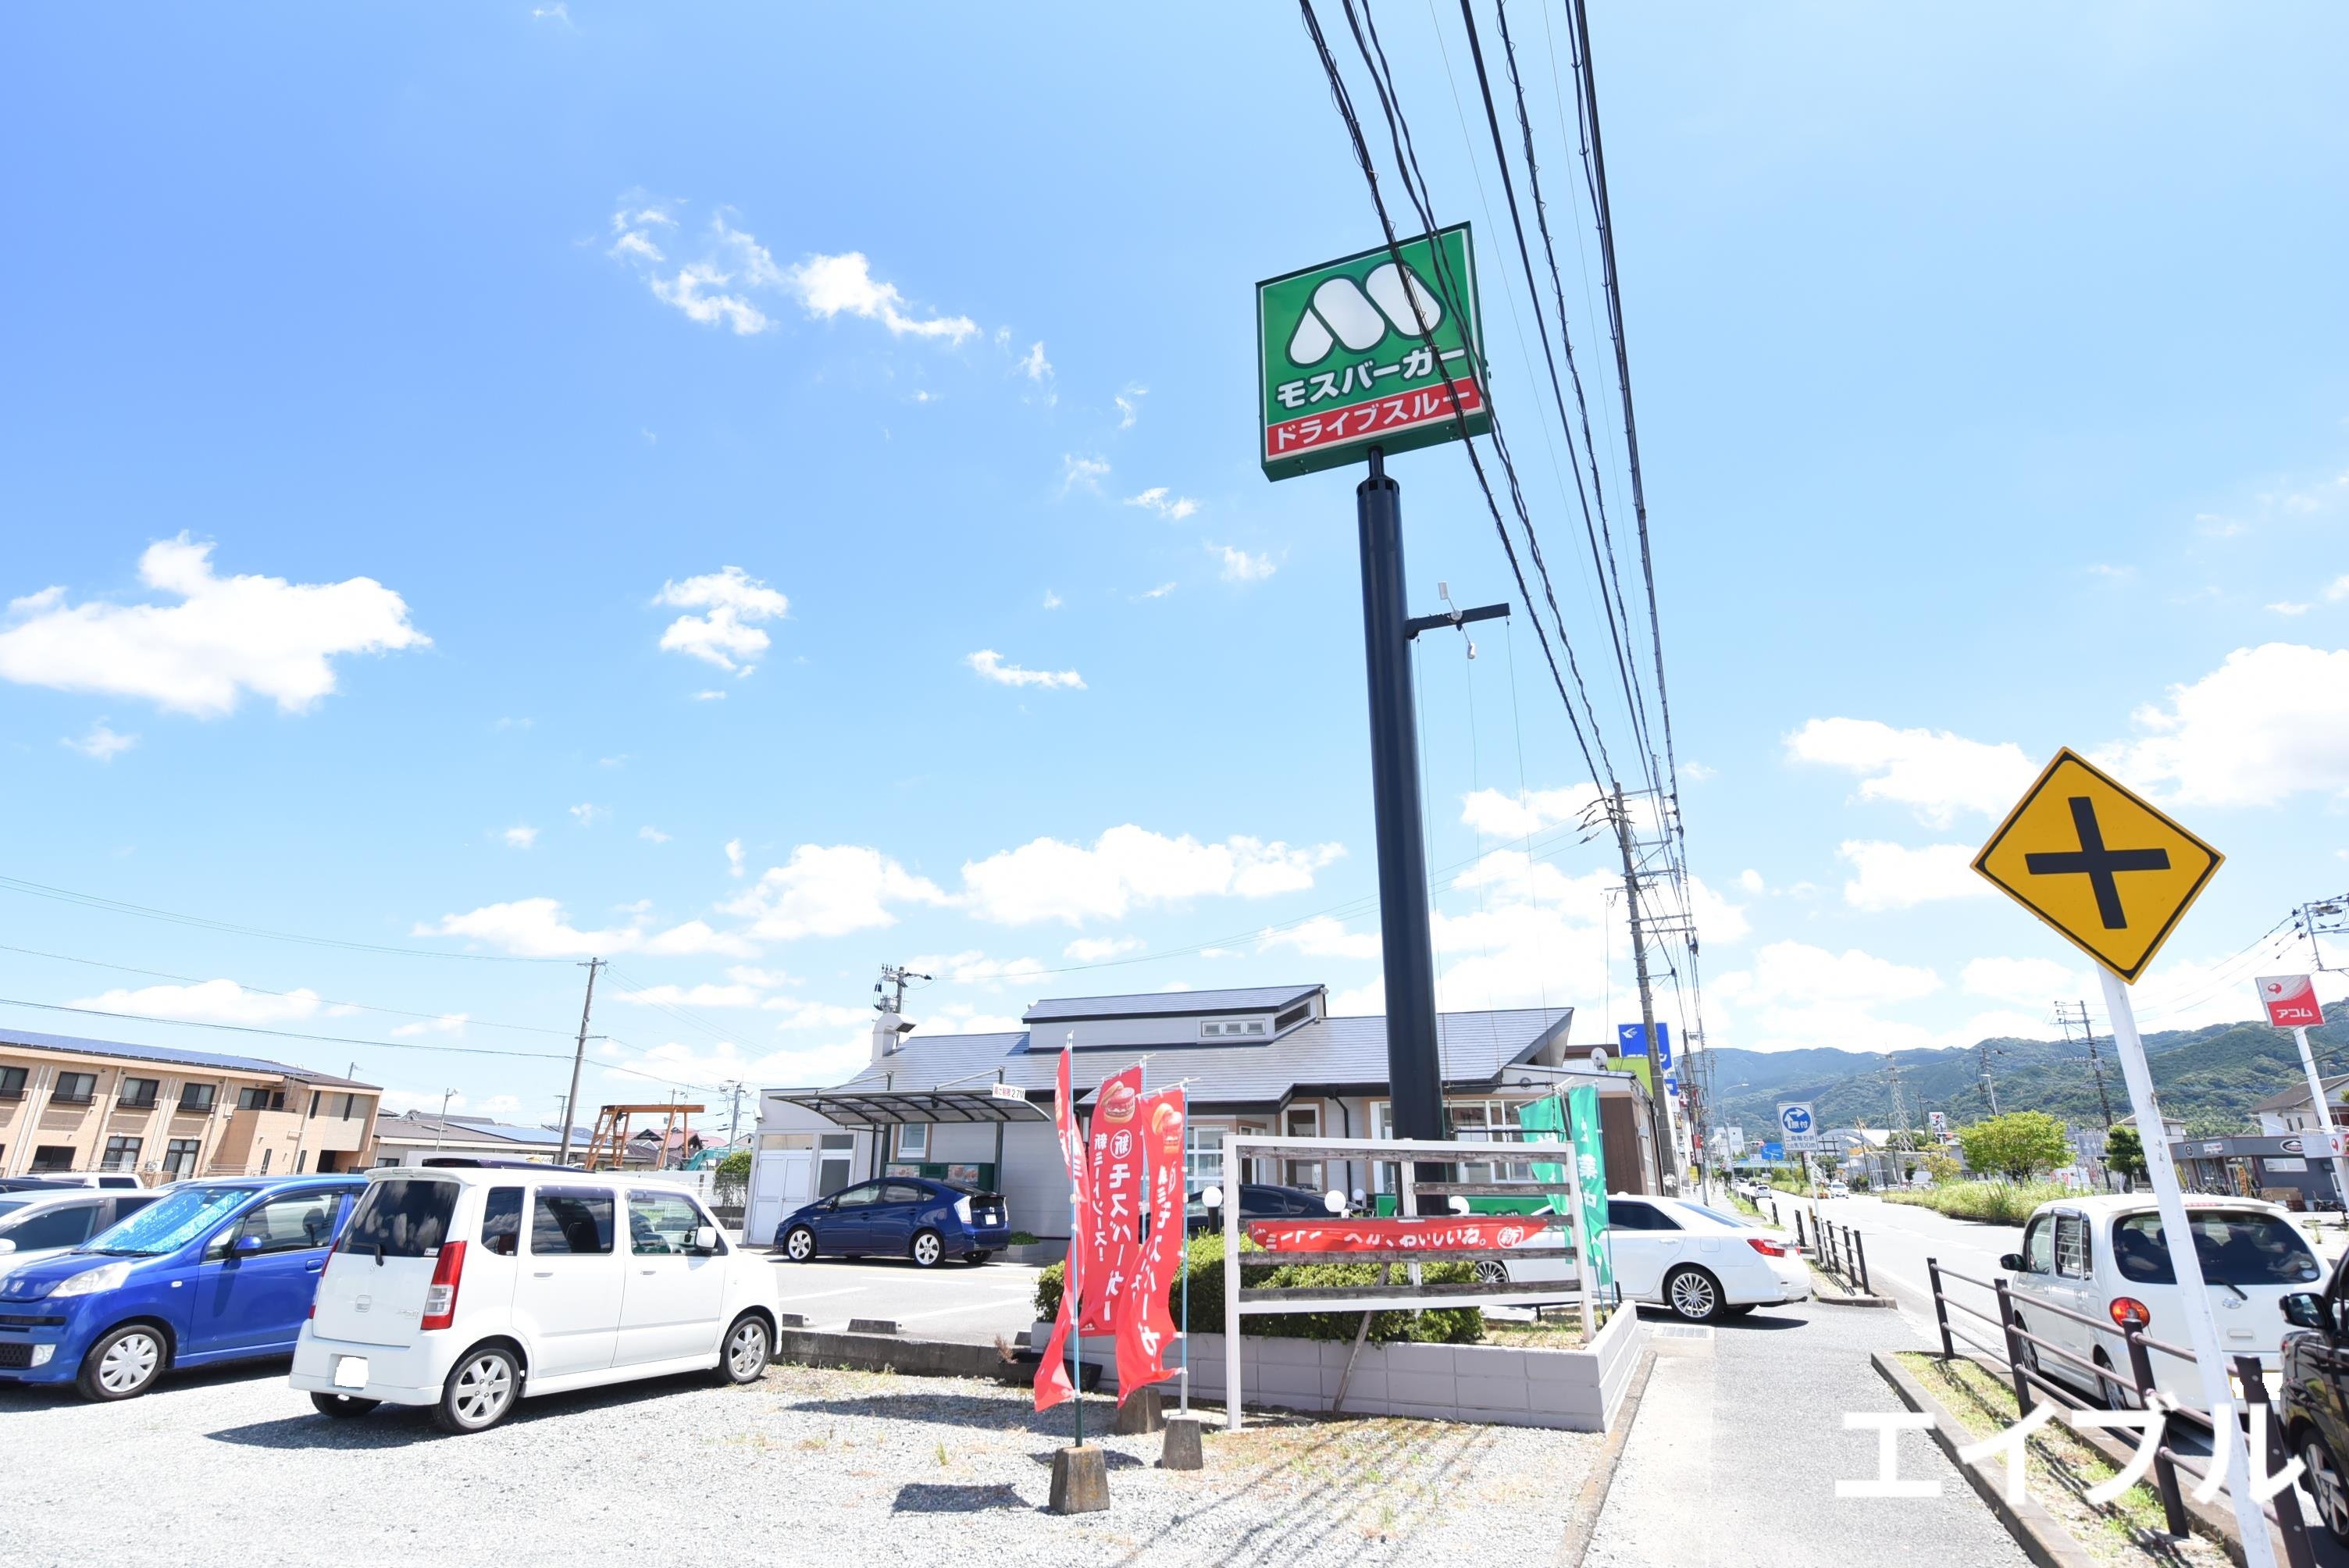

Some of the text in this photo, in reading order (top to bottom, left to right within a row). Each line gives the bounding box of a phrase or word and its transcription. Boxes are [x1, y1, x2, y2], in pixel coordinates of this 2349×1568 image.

[1278, 347, 1465, 408] モスバーガー
[1278, 391, 1470, 451] ドライブスルー
[2276, 1007, 2313, 1019] アコム
